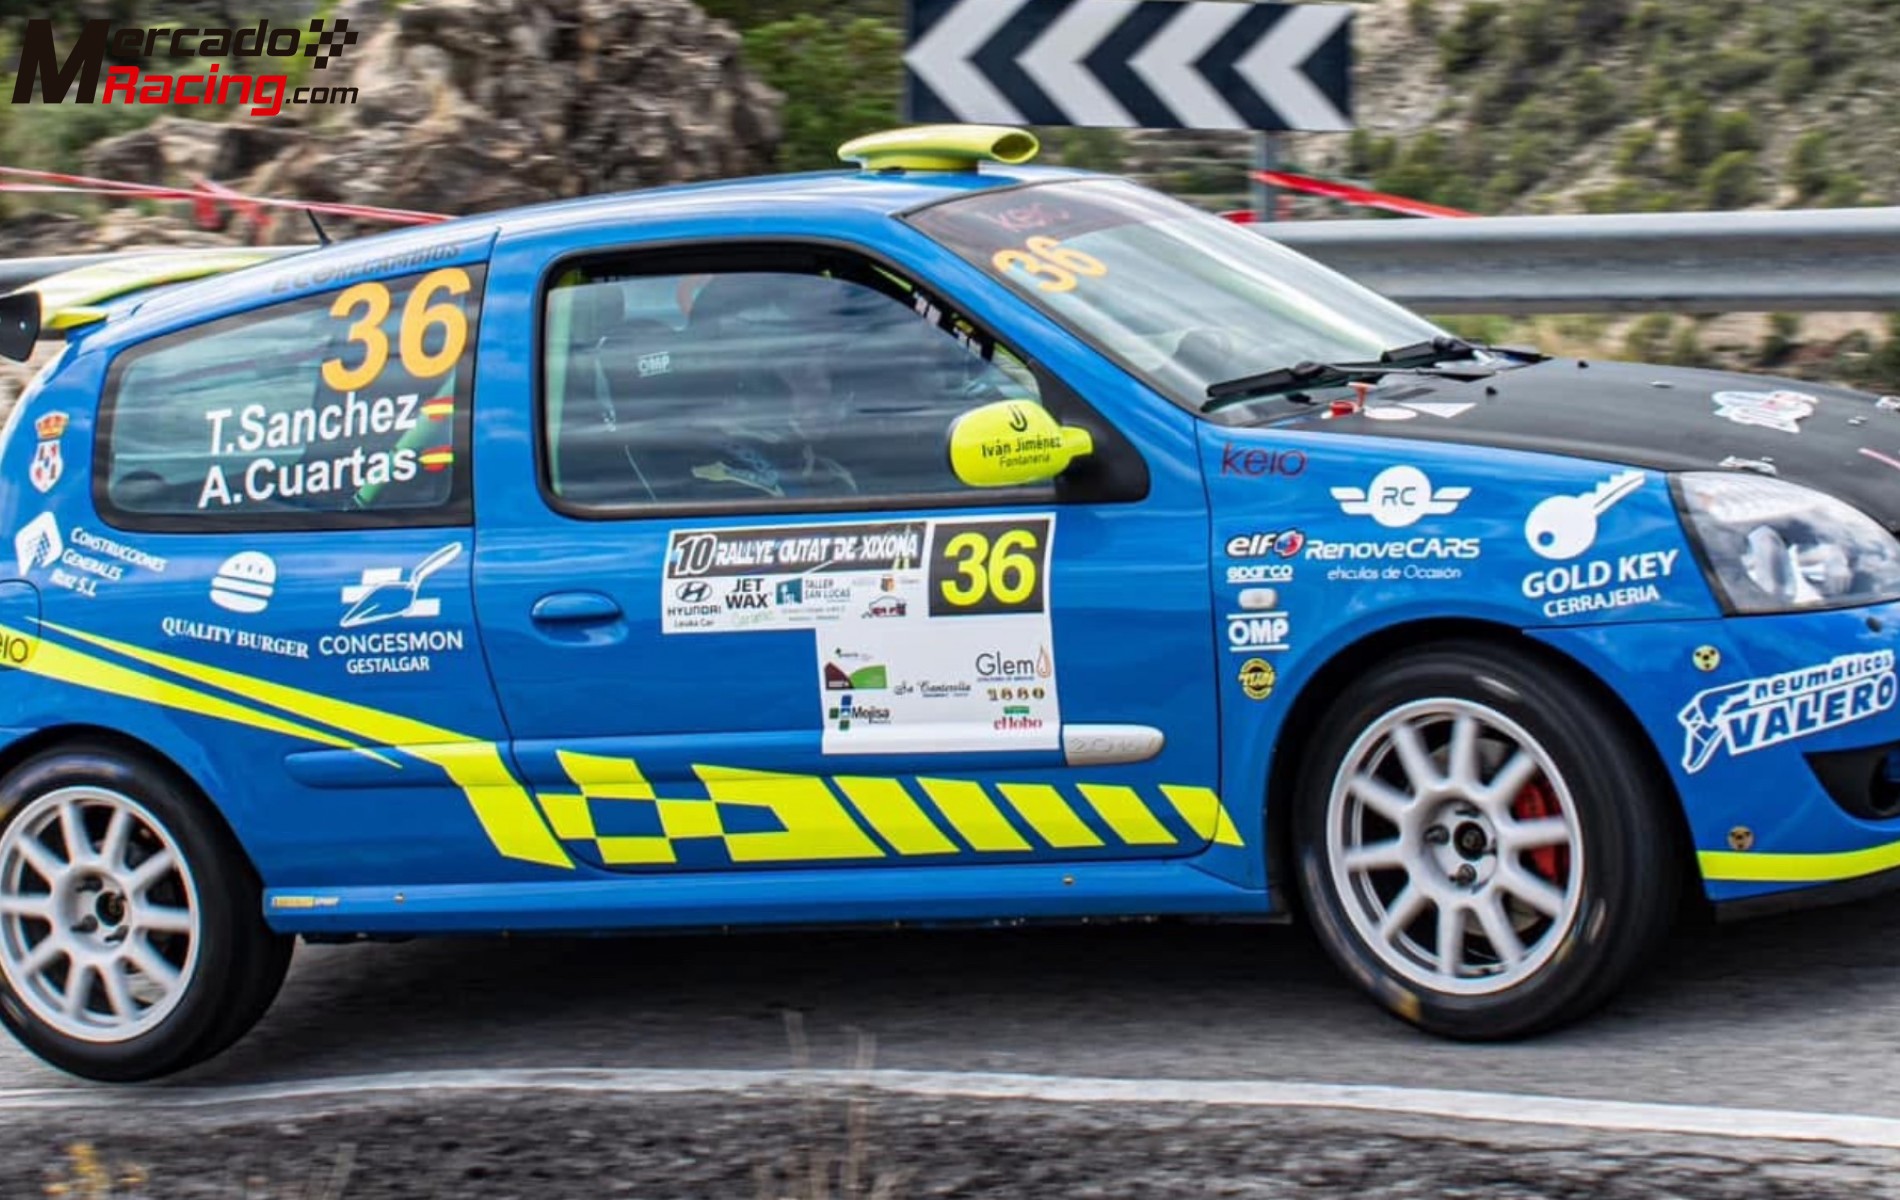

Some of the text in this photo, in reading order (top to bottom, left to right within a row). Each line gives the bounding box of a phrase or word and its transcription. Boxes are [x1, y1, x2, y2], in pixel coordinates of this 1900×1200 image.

[992, 236, 1107, 292] 36
[322, 268, 471, 391] 36
[638, 355, 671, 375] OMP
[206, 391, 418, 455] T.Sanchez
[981, 434, 1062, 457] Iván Jiménez
[198, 447, 417, 508] A.Cuartas
[1382, 486, 1417, 506] RC
[675, 533, 718, 576] 10
[715, 540, 776, 567] RALLYE
[831, 535, 858, 562] DE
[859, 532, 919, 560] XIXONA
[1226, 533, 1276, 558] elf
[1304, 537, 1481, 560] RenoveCARS
[940, 529, 1038, 606] 36
[1226, 564, 1294, 582] sparco
[1381, 565, 1400, 580] de
[1521, 549, 1680, 598] GOLD KEY
[732, 578, 765, 593] JET
[804, 579, 834, 590] TALLER
[725, 592, 768, 609] WAX
[1543, 584, 1661, 618] CERRAJERIA
[161, 616, 310, 659] QUALITY BURGER
[318, 630, 464, 656] CONGESMON
[1228, 618, 1289, 646] OMP
[346, 656, 431, 675] GESTALGAR
[975, 650, 1035, 676] Glem
[1727, 671, 1898, 754] VALERO
